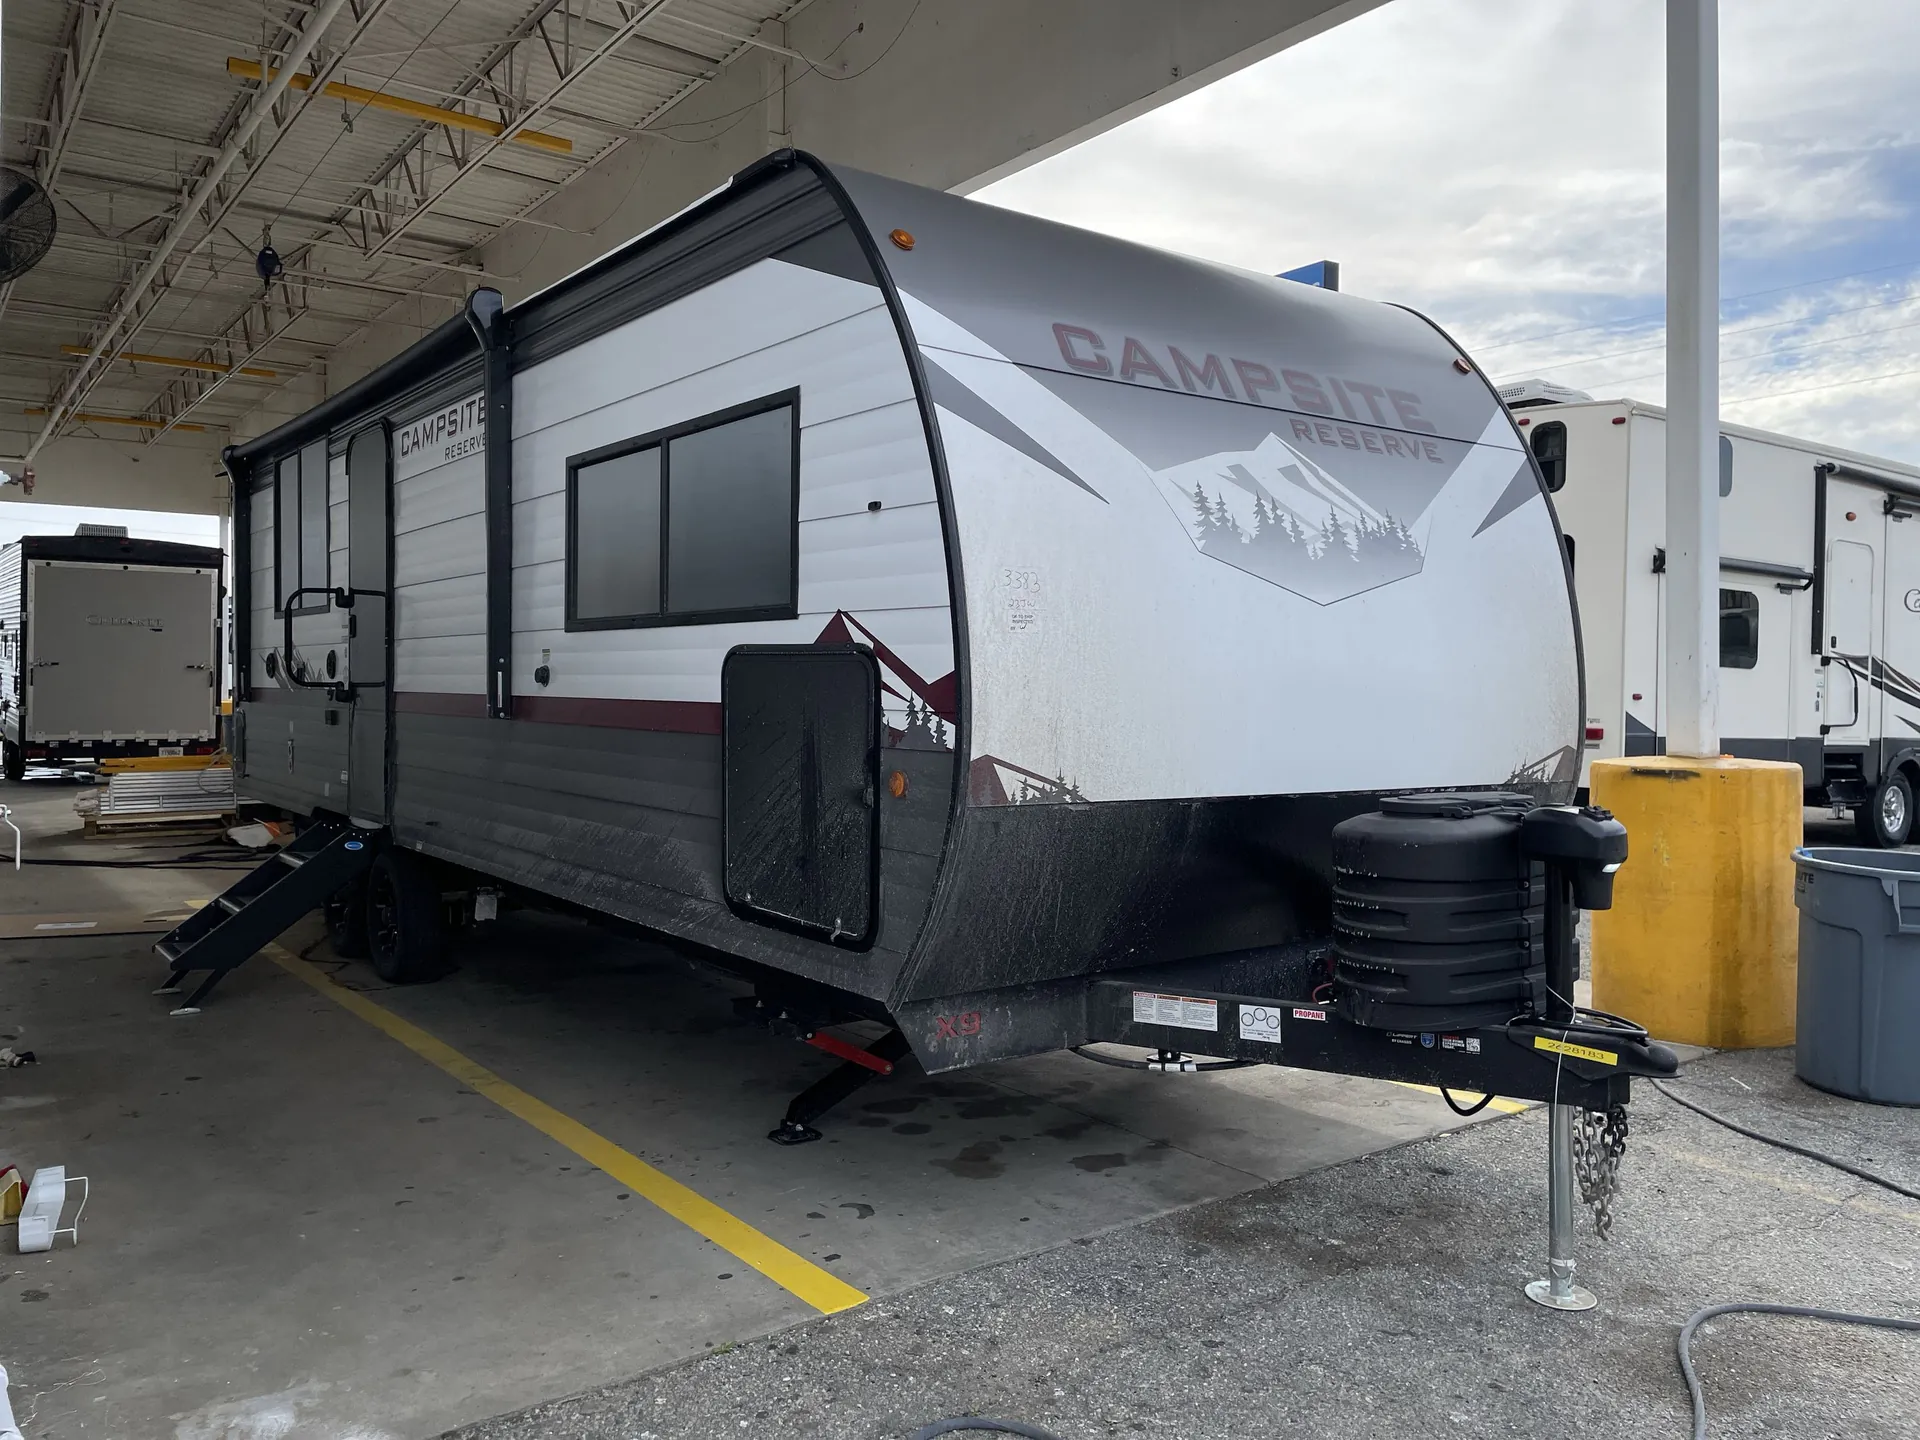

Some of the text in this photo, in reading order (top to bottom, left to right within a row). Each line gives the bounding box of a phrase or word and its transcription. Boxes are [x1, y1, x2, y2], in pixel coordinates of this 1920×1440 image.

[1052, 322, 1437, 433] CAMPSITE
[401, 396, 485, 457] CAMPSITE
[1289, 418, 1445, 463] RESERVE
[1003, 568, 1041, 594] 3383
[935, 1011, 982, 1040] X9
[1294, 1009, 1325, 1020] PROPANE
[1547, 1041, 1604, 1060] 2628183
